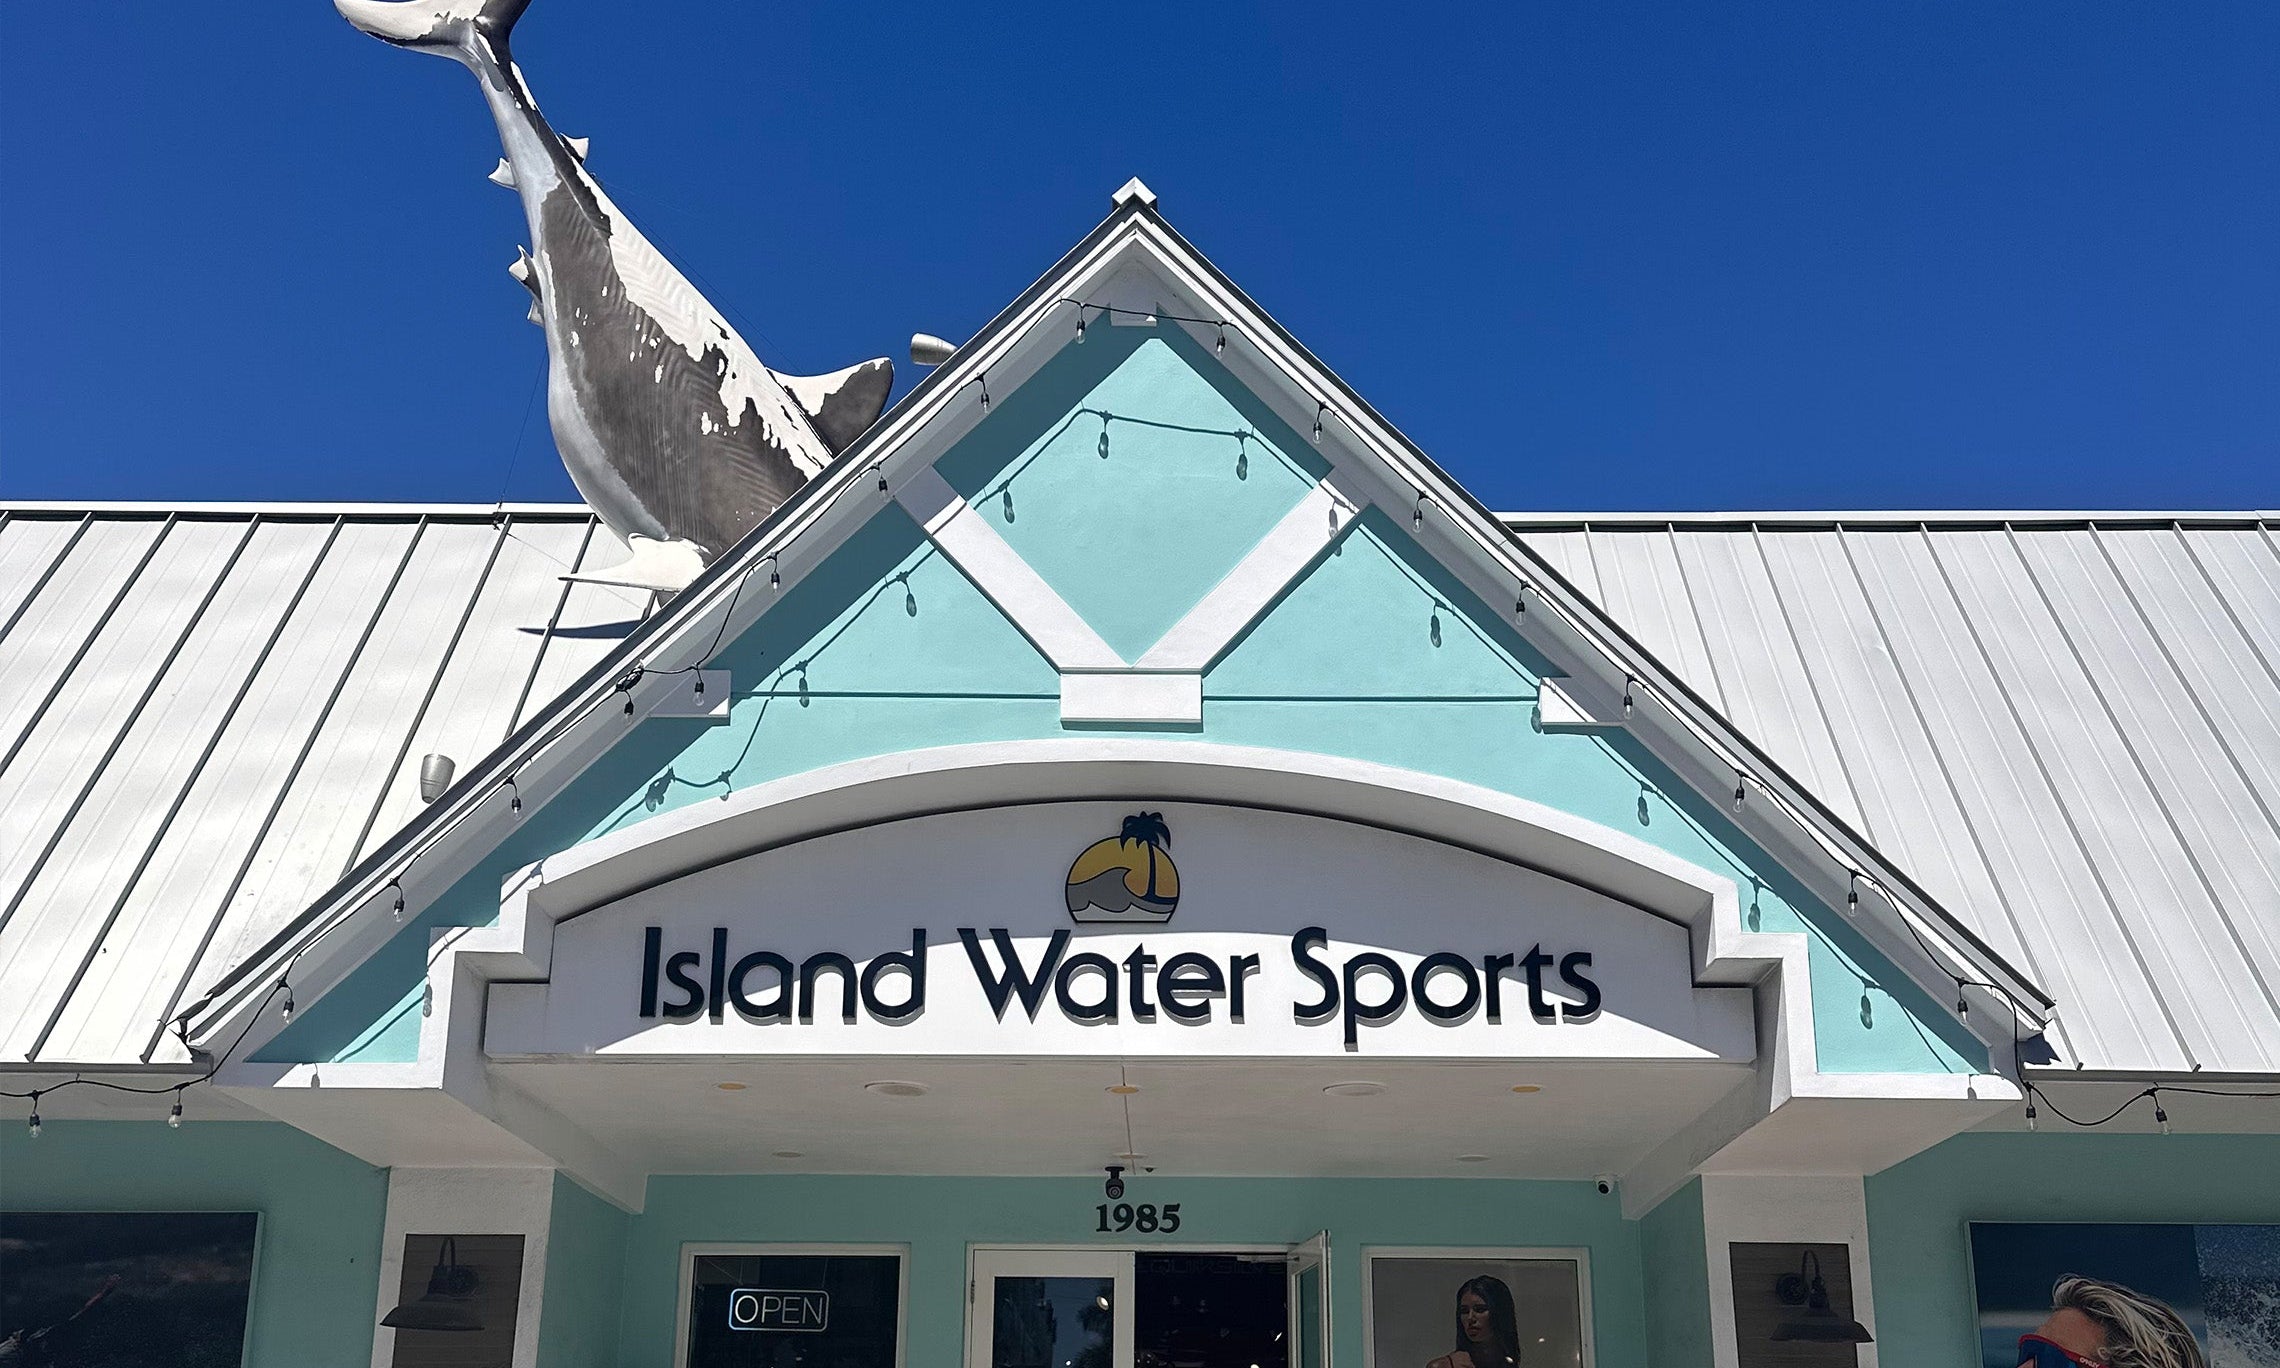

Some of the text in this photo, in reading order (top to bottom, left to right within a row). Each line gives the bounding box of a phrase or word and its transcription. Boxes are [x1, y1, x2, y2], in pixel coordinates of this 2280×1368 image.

[640, 926, 1603, 1052] Island Water Sports
[1096, 1203, 1181, 1233] 1985
[734, 1294, 824, 1326] OPEN
